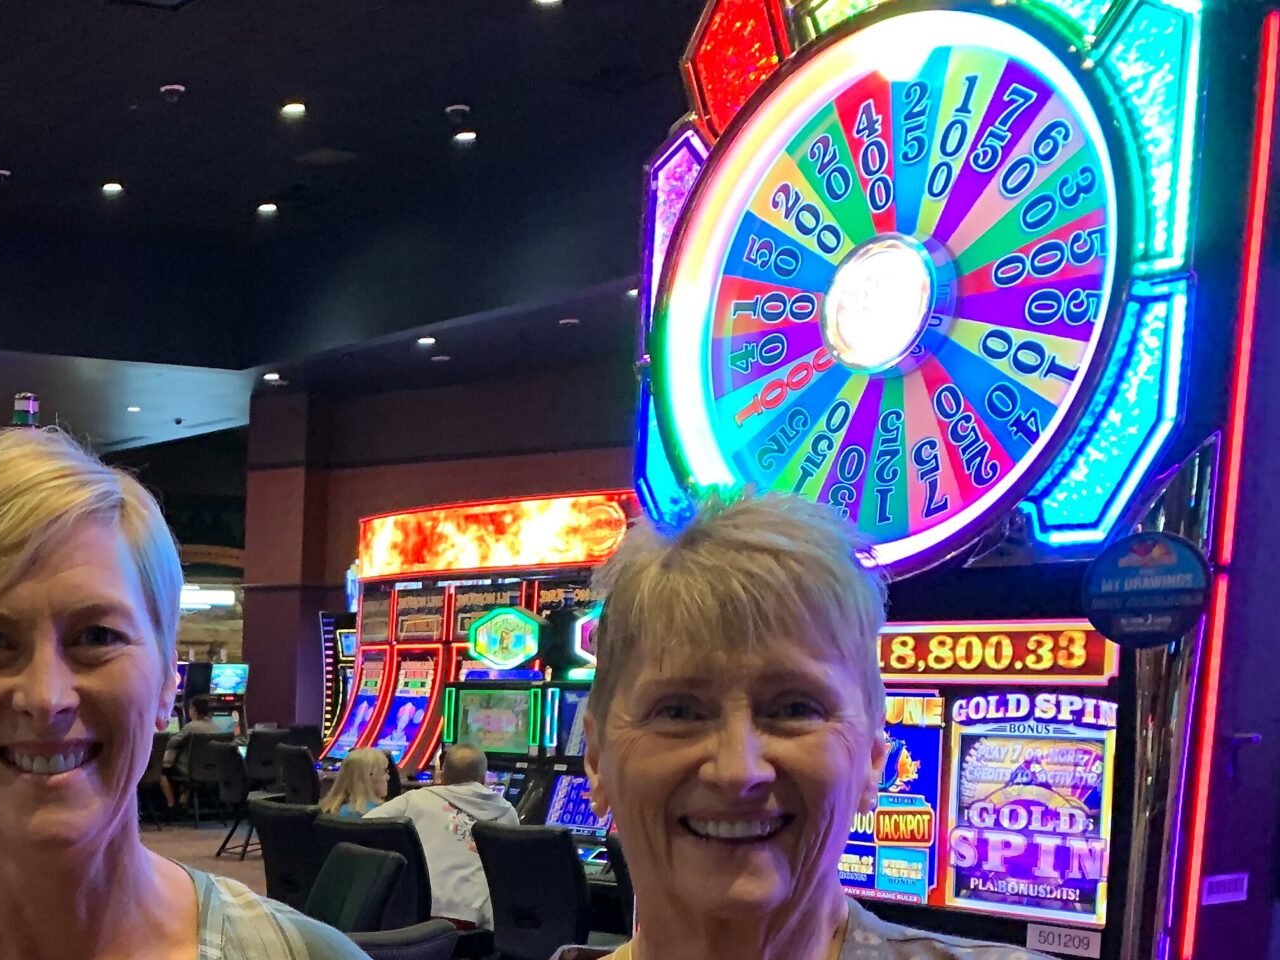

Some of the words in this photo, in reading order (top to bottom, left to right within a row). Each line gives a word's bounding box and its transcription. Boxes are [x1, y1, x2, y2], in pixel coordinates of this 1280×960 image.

[901, 81, 931, 164] 25
[927, 74, 979, 199] 100
[970, 83, 1037, 172] 75
[808, 133, 852, 202] 20
[853, 98, 894, 213] 400
[1000, 118, 1072, 198] 60
[772, 183, 842, 255] 200
[1020, 165, 1097, 232] 30
[743, 234, 801, 279] 50
[992, 225, 1107, 287] 500
[732, 291, 817, 324] 100
[1025, 288, 1103, 326] 50
[729, 333, 787, 374] 40
[979, 328, 1081, 382] 100
[733, 346, 837, 427] 1000
[984, 381, 1043, 446] 40
[756, 407, 810, 472] 25
[791, 399, 851, 495] 150
[874, 409, 904, 525] 125
[933, 383, 1001, 488] 250
[829, 445, 866, 520] 30
[912, 438, 949, 520] 75
[952, 693, 1030, 722] GOLD
[1034, 693, 1118, 727] SPIN
[1009, 723, 1051, 735] BONUS
[1010, 743, 1022, 761] 7
[879, 814, 931, 840] JACKPOT
[970, 800, 1089, 834] GOLD
[949, 826, 1107, 880] SPIN
[1038, 930, 1091, 951] 501209
